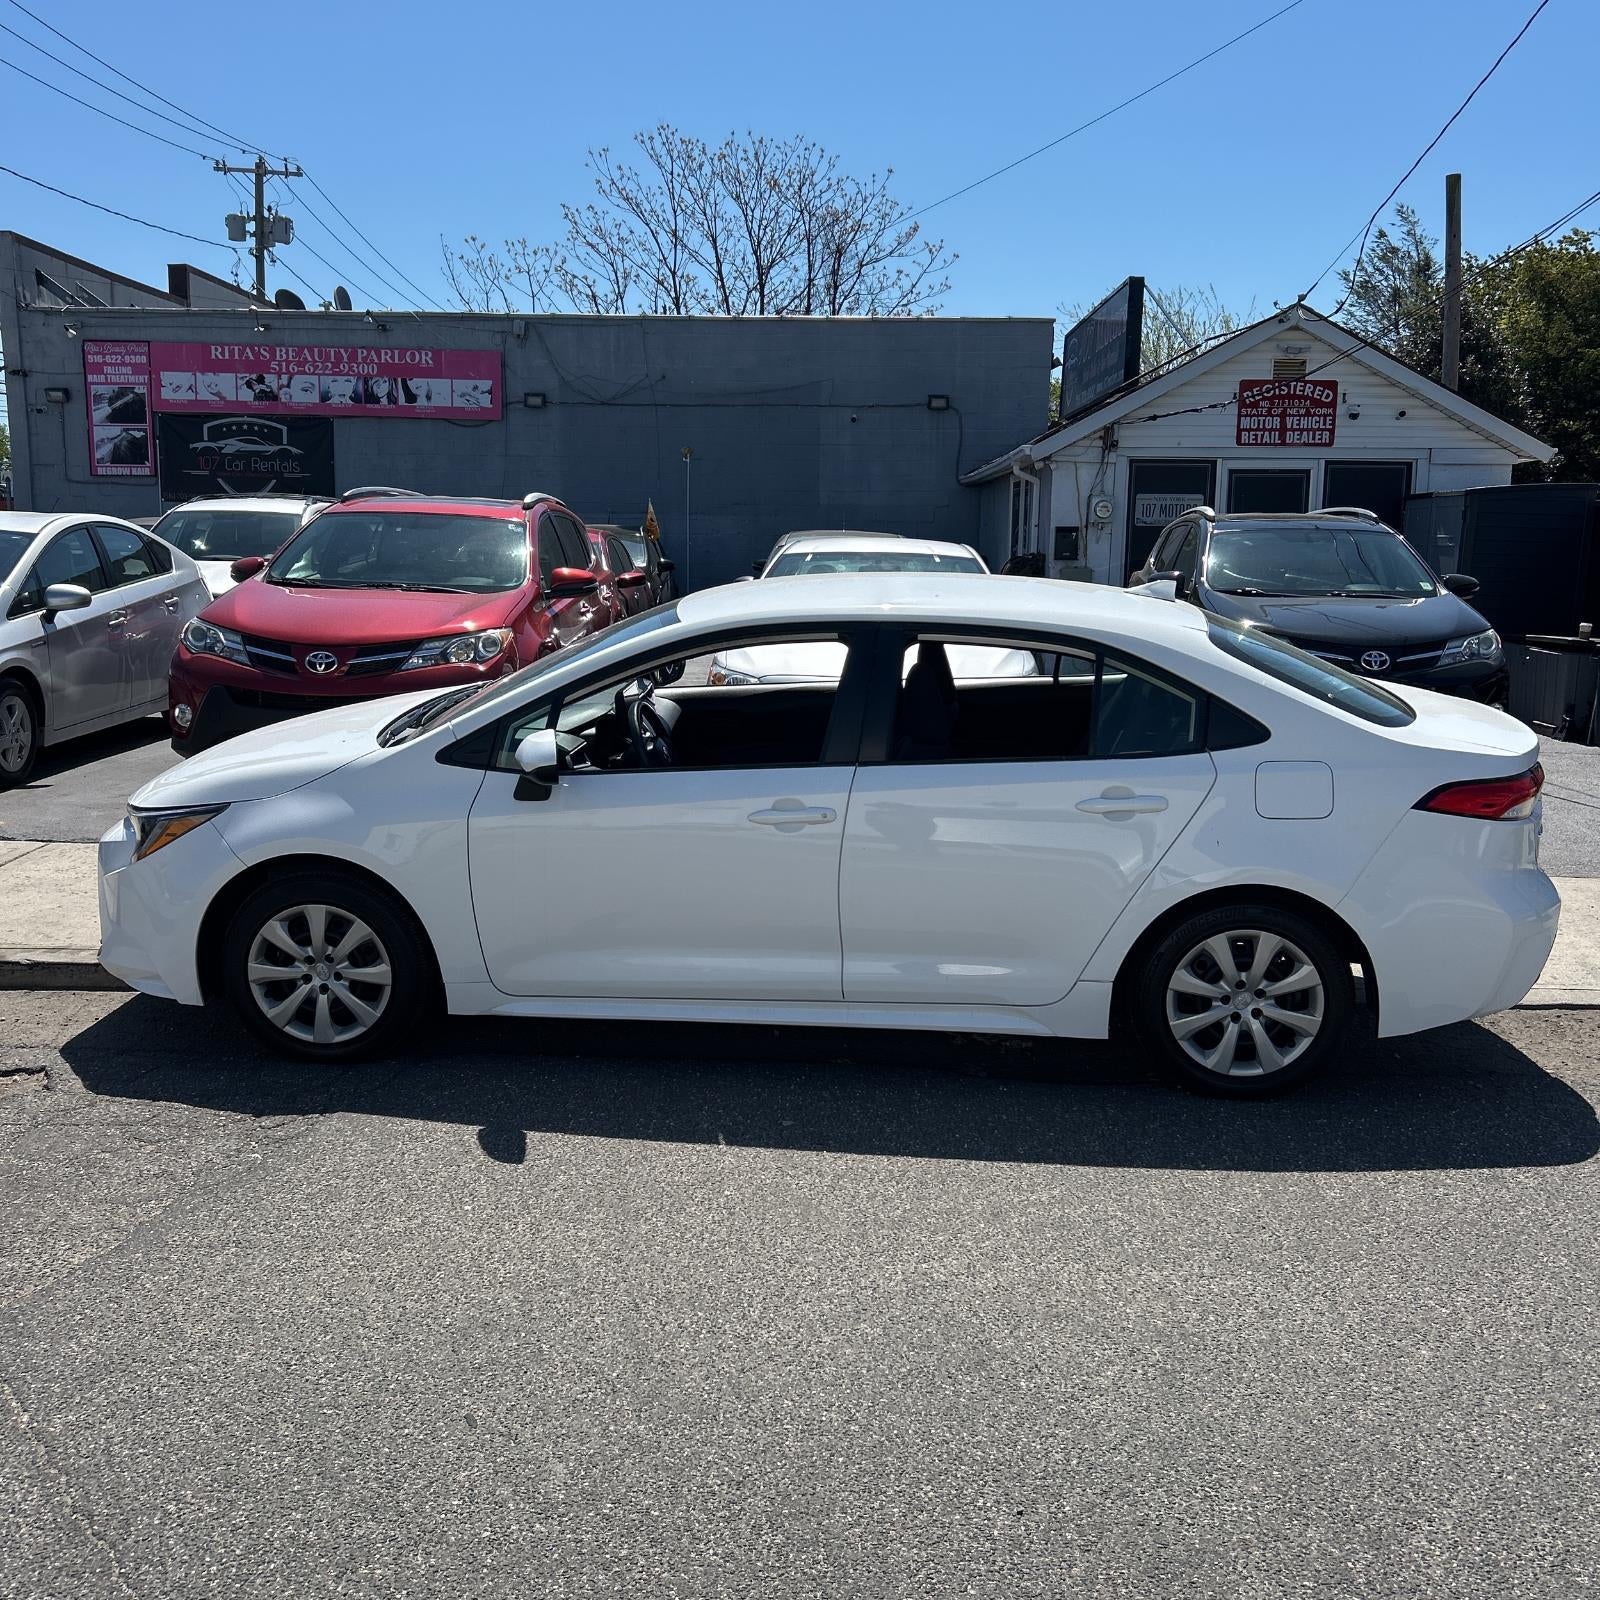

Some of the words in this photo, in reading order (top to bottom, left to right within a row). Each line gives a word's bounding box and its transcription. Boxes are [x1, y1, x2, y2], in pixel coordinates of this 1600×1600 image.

[103, 342, 126, 355] Beauty
[127, 342, 148, 353] Parlor
[210, 345, 270, 360] RITA'S
[275, 347, 351, 362] BEAUTY
[357, 348, 433, 364] PARLOR
[87, 354, 147, 363] 516-622-9300
[103, 365, 132, 374] FALLING
[270, 361, 378, 375] 516-622-9300
[87, 374, 105, 383] HAIR
[106, 374, 149, 383] TREATMENT
[1243, 381, 1333, 404] REGISTERED
[1240, 416, 1280, 429] MOTOR
[1286, 416, 1333, 429] VEHICLE
[1241, 431, 1281, 444] RETAIL
[1285, 431, 1330, 444] DEALER
[197, 455, 220, 470] 107
[225, 456, 246, 471] Car
[251, 457, 301, 472] Rentals
[97, 466, 130, 475] REGROW
[131, 466, 150, 475] HAIR
[1141, 503, 1156, 518] 107
[1159, 503, 1198, 518] MOTO
